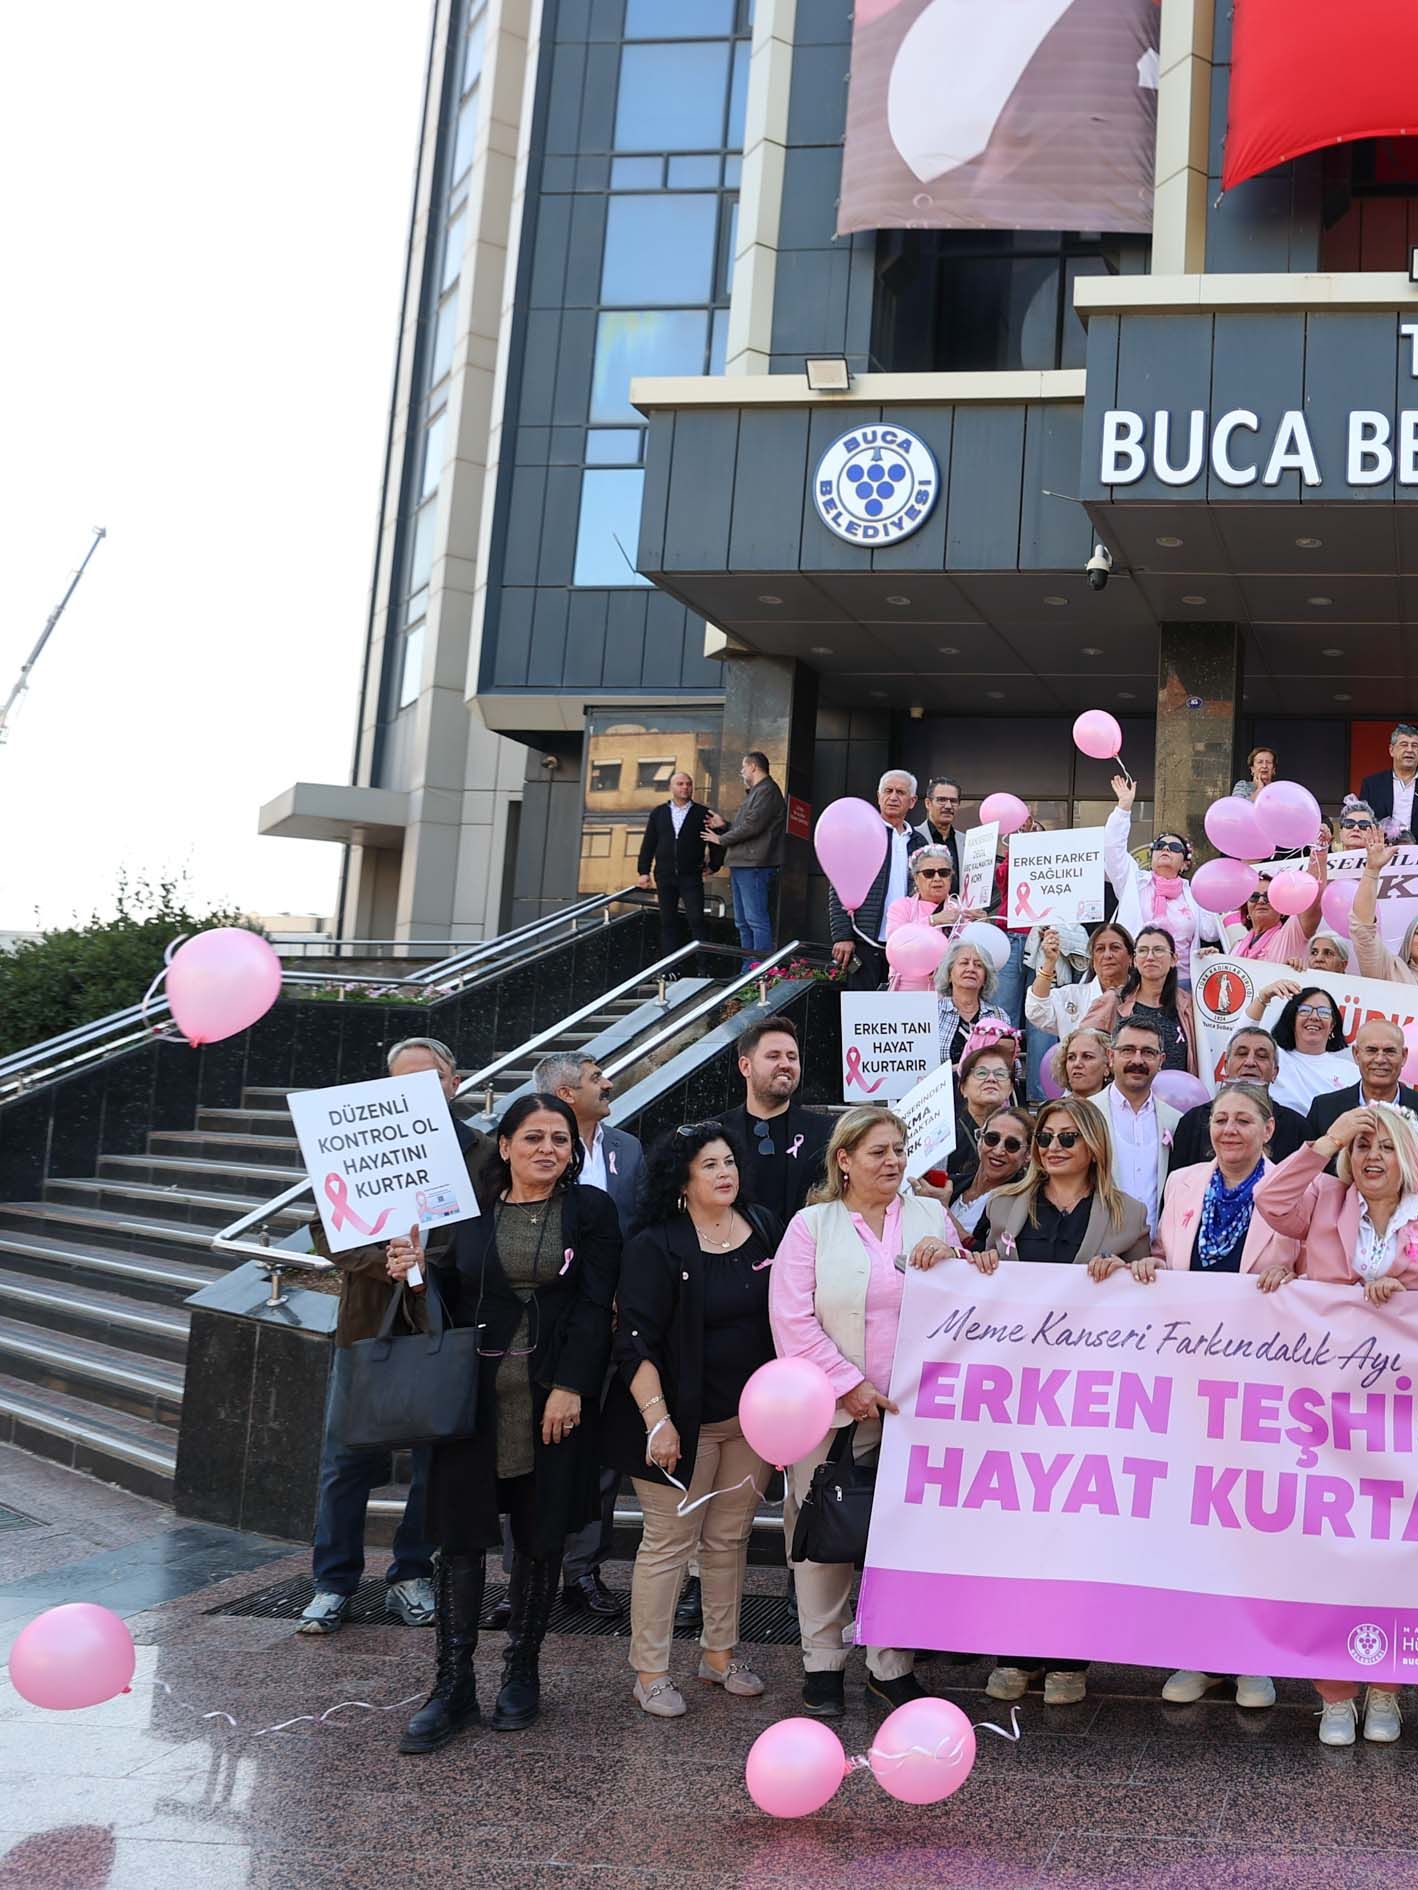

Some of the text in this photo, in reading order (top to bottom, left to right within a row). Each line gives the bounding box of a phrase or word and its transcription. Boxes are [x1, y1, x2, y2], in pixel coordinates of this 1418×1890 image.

[843, 430, 912, 454] BUCA
[1100, 408, 1322, 489] BUCA
[1013, 851, 1100, 867] ERKEN FARKET
[1030, 867, 1083, 881] SAĞLIKLI
[1040, 883, 1072, 896] YAŞA
[854, 1022, 931, 1036] ERKEN TANI
[873, 1041, 914, 1053] HAYAT
[861, 1059, 927, 1073] KURTARIR
[328, 1094, 410, 1126] DÜZENLİ
[318, 1117, 439, 1154] KONTROL OL
[343, 1143, 428, 1175] HAYATINI
[355, 1169, 430, 1199] KURTAR
[926, 1305, 1403, 1386] Meme Kanseri Farkındalık Ayı
[914, 1361, 1174, 1435] ERKEN
[904, 1444, 1168, 1520] HAYAT
